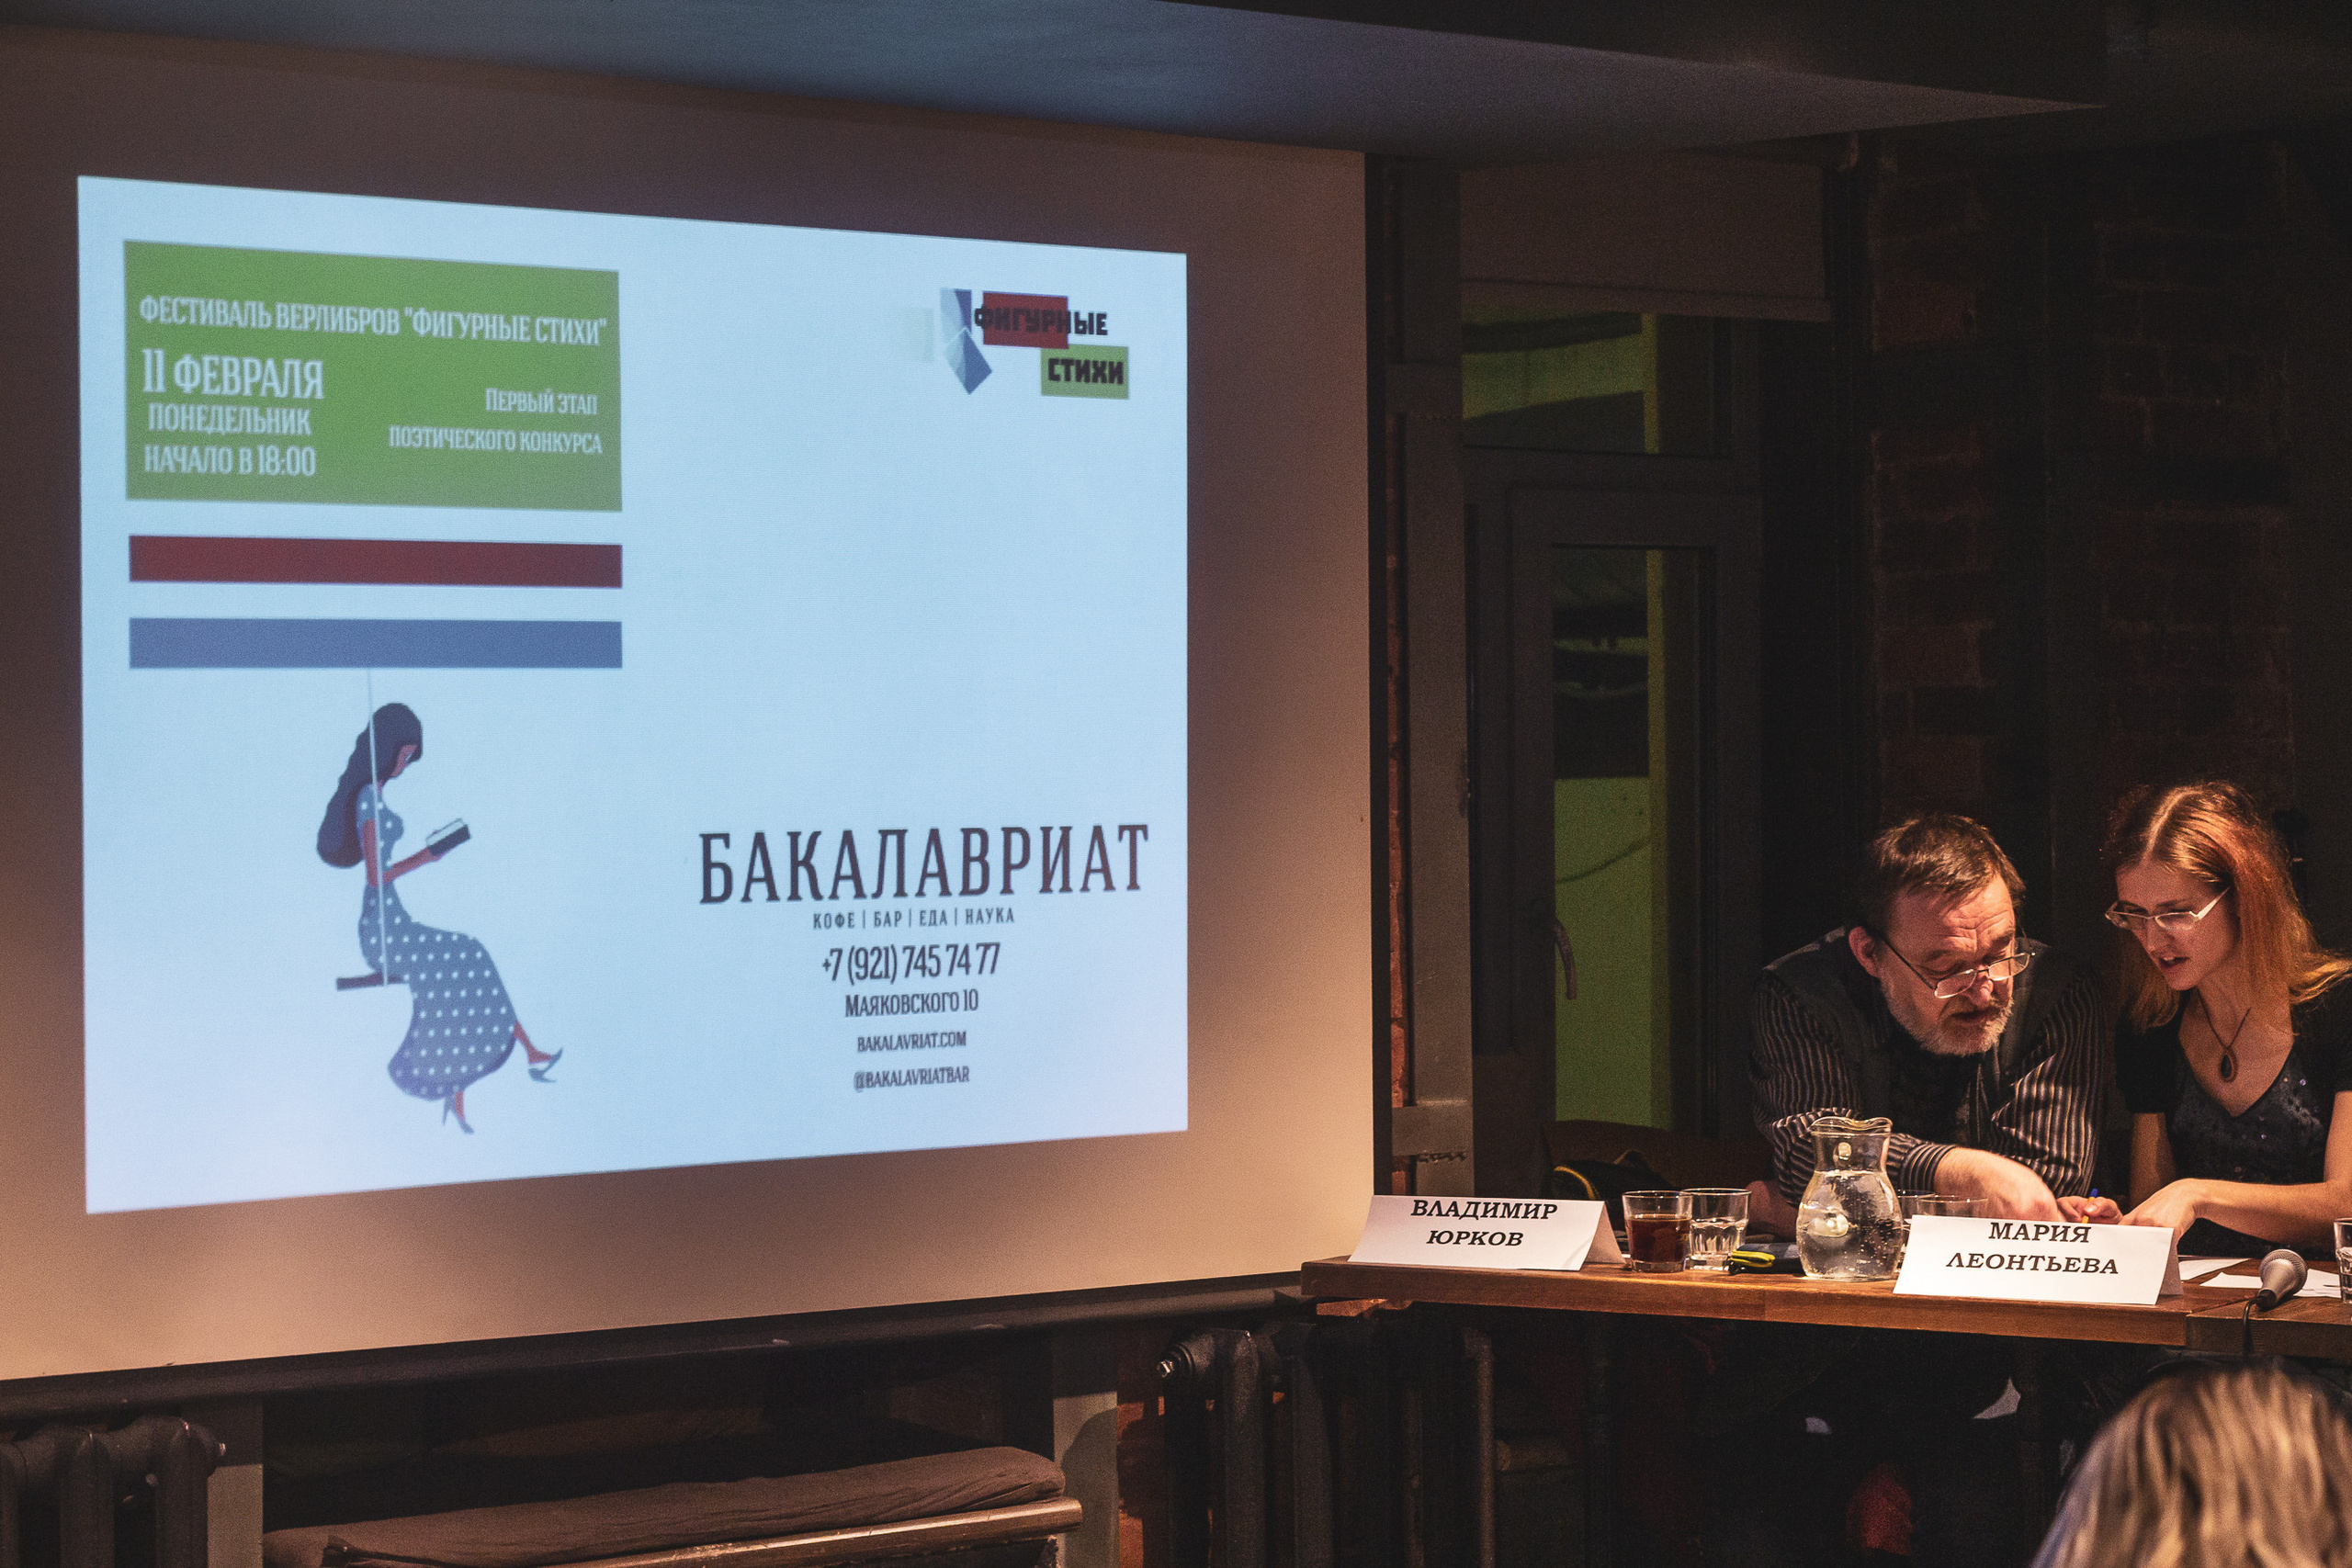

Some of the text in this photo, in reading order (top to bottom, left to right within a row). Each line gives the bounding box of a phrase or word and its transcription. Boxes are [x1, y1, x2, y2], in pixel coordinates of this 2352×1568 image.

[139, 295, 607, 346] ФЕСТИВАЛЬ ВЕРЛИБРОВ "ФИГУРНЫЕ СТИХИ"
[975, 306, 1108, 335] ФИГУРНЫЕ
[142, 349, 324, 399] 11 ФЕВРАЛЯ
[1047, 358, 1124, 385] СТИХИ
[557, 393, 597, 415] ЭТАП
[148, 402, 311, 436] ПОНЕДЕЛЬНИК
[389, 425, 603, 455] ПОЭТИЧЕСКОГО КОНКУРСА
[143, 445, 316, 477] НАЧАЛО В 18:00
[699, 824, 1148, 904] БАКАЛАВРИАТ
[813, 908, 1015, 930] КОФЕ БАР ЕДА НАУКА
[822, 942, 1001, 986] +7 (921) 745 74 77
[963, 988, 978, 1010] 10
[857, 1031, 967, 1054] BAKALAVRIAT.COM
[854, 1066, 970, 1092] @BAKALAVRIATBAR
[1410, 1200, 1558, 1220] ВЛАДИМИР
[1426, 1230, 1523, 1247] ЮРКОВ
[1988, 1222, 2091, 1243] МАРИЯ
[1946, 1252, 2119, 1275] ЛЕОНТЬЕВА
